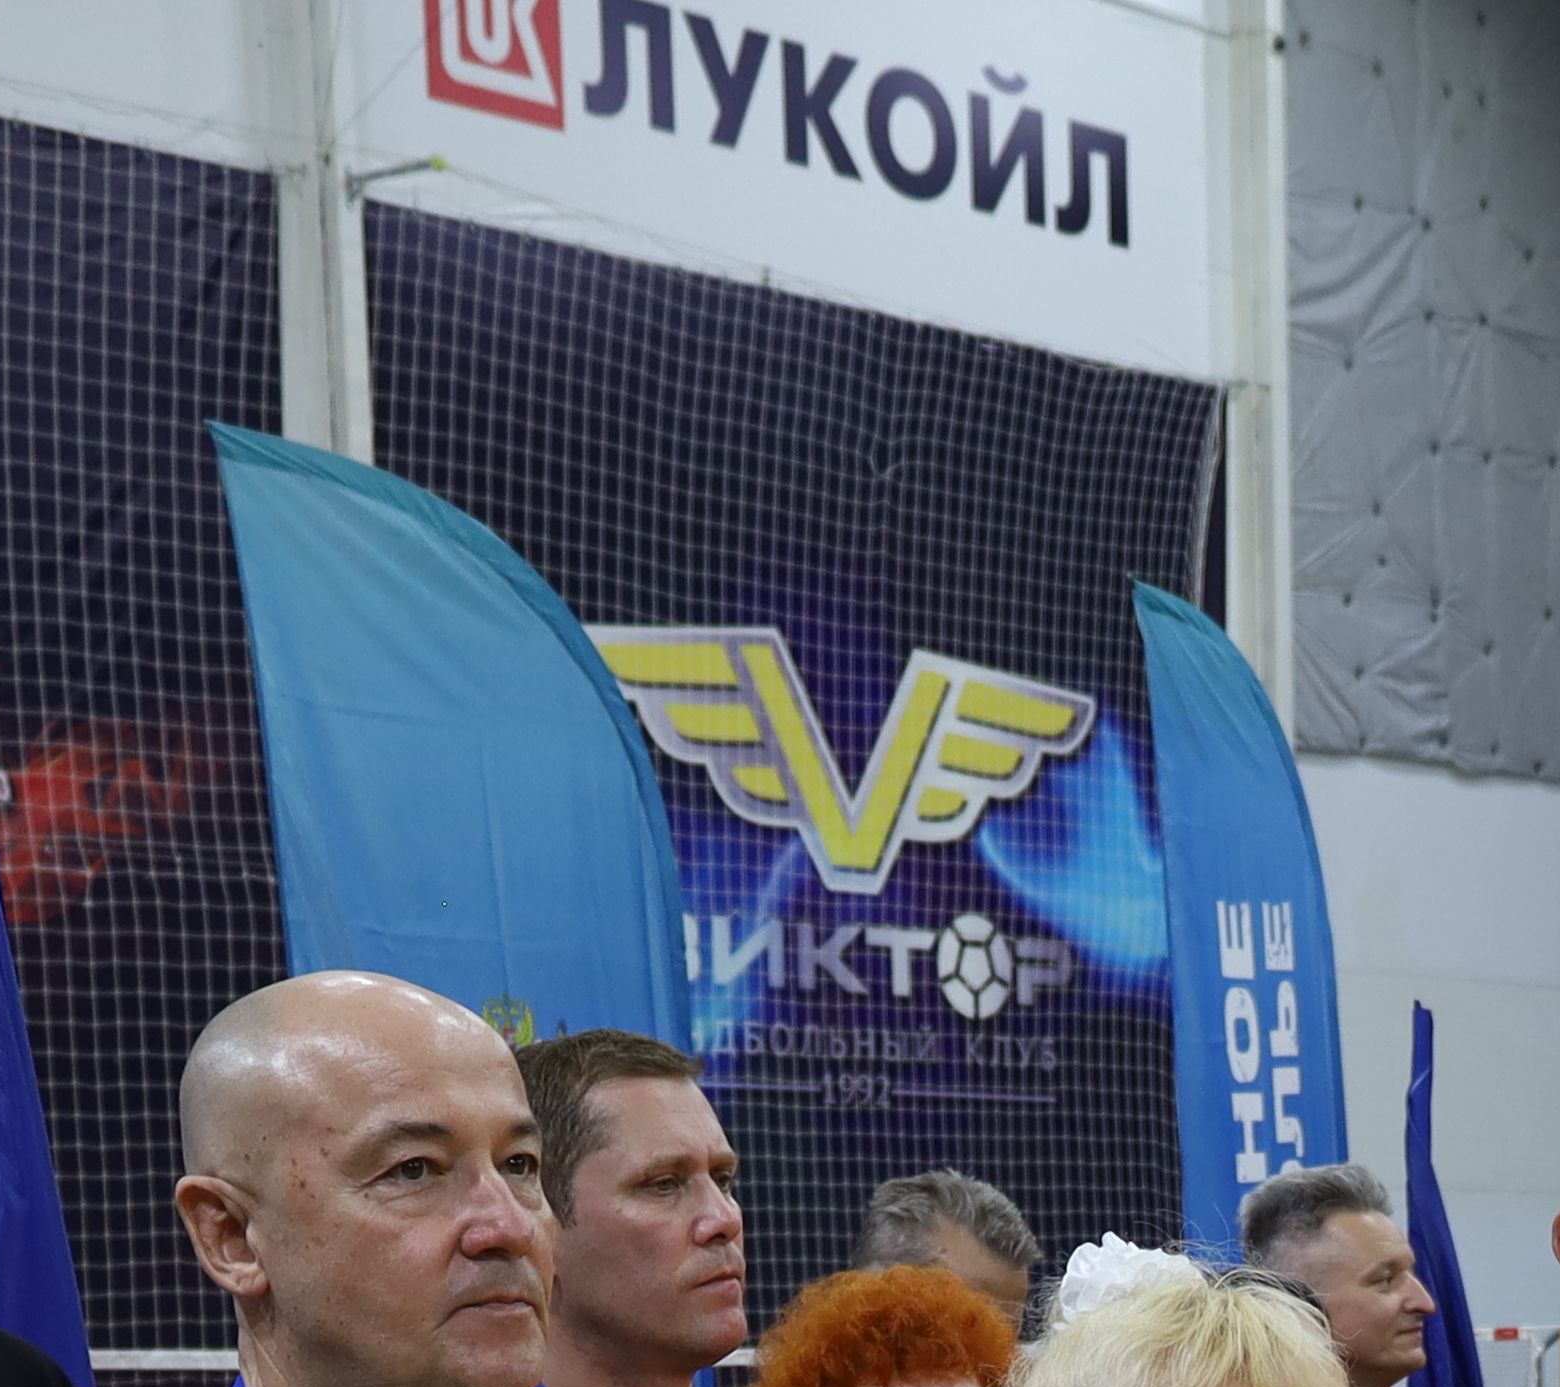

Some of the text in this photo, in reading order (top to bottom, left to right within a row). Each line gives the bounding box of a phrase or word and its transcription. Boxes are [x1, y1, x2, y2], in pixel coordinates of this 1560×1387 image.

[583, 0, 1130, 249] ЛУКОЙЛ
[966, 1035, 1058, 1070] КЛУБ
[822, 1073, 890, 1108] 1992
